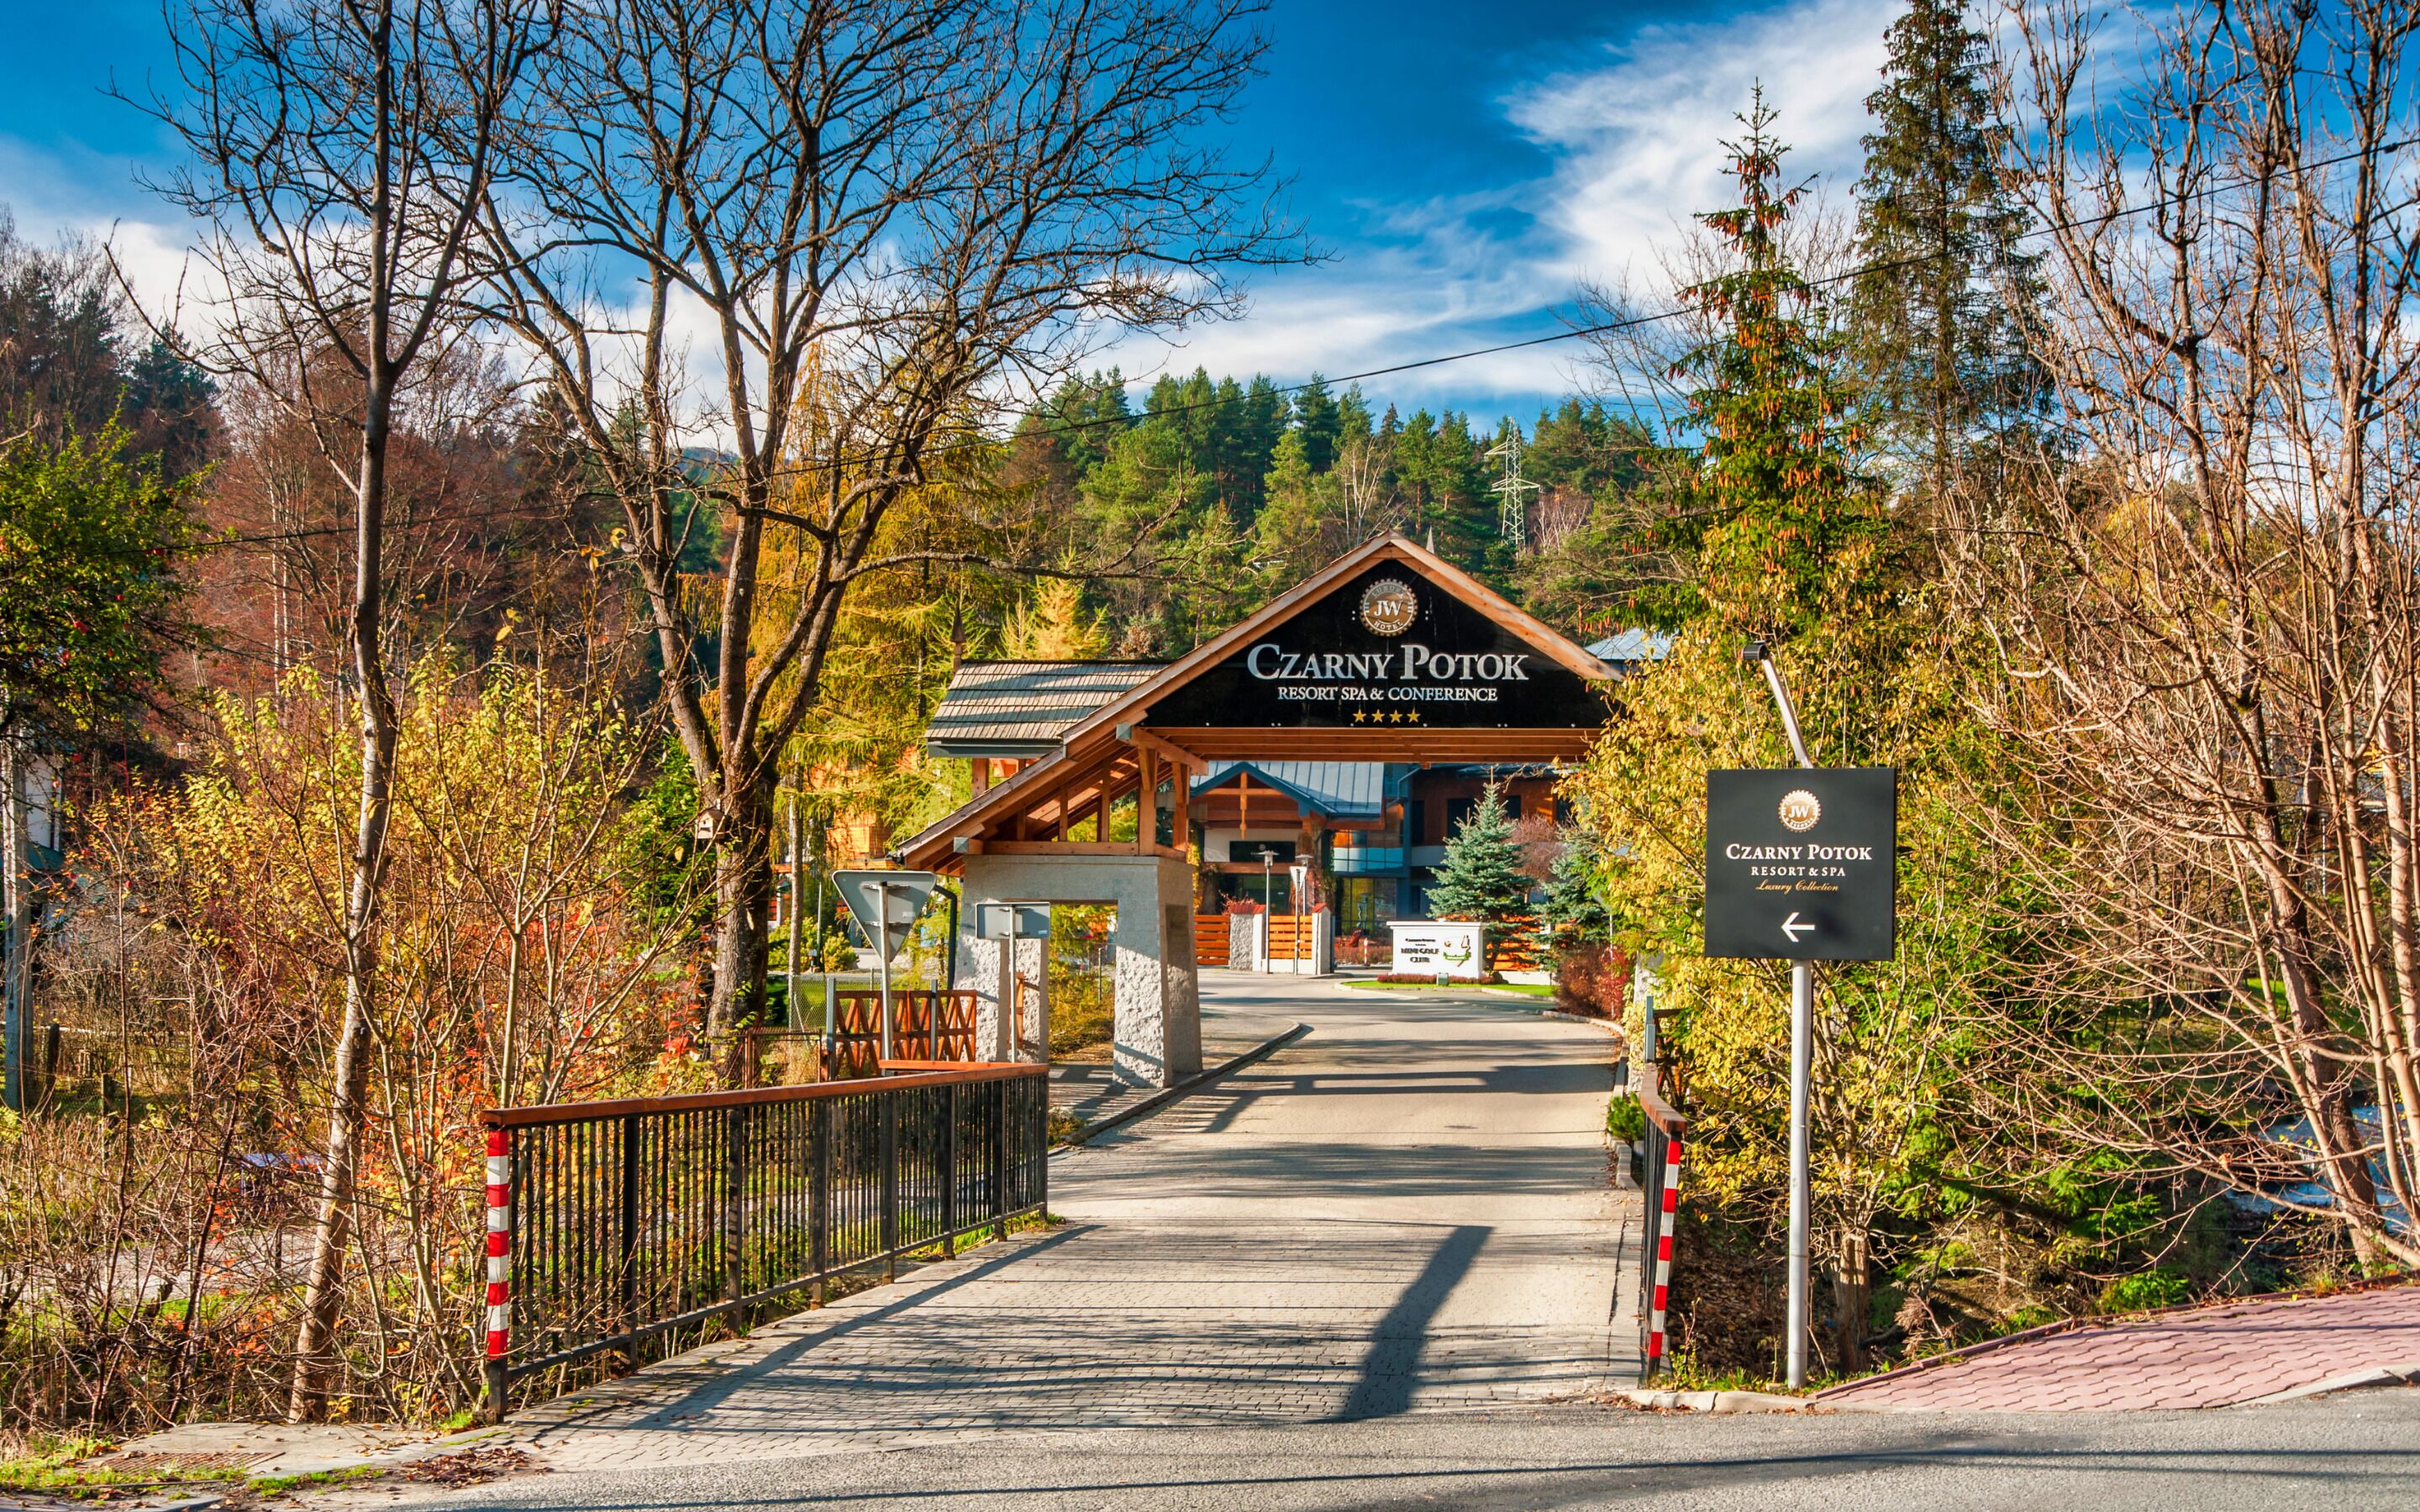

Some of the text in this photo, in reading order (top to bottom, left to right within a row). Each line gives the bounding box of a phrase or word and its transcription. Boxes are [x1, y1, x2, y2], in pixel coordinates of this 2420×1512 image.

[1374, 600, 1403, 617] JW
[1374, 621, 1403, 630] HOTEL
[1247, 643, 1529, 681] CZARNY POTOK
[1277, 686, 1497, 701] RESORT SPA & CONFERENCE
[1788, 806, 1810, 818] JW
[1726, 843, 1872, 860] CZARNY POTOK
[1751, 866, 1846, 876] RESORT & SPA
[1755, 879, 1839, 894] Luxury Collection
